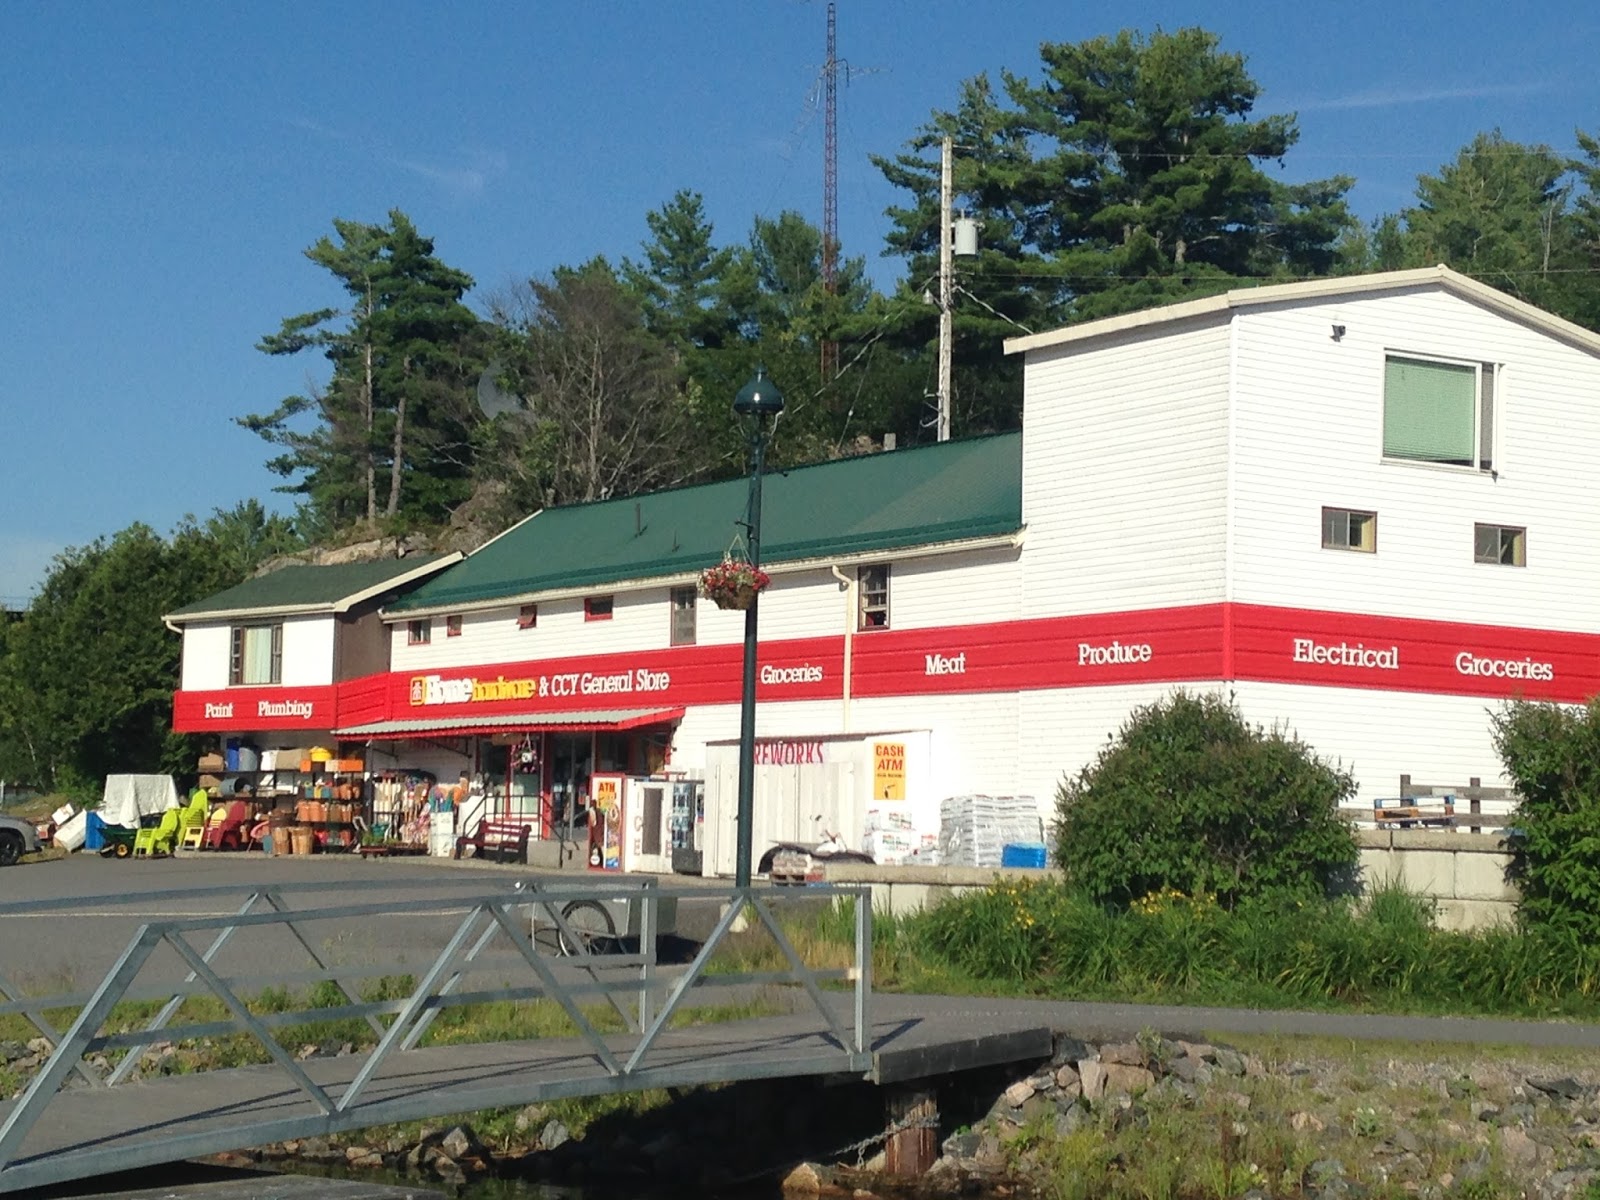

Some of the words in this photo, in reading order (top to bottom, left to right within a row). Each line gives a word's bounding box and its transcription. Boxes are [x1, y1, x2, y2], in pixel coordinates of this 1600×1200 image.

[925, 652, 966, 676] Meat
[1078, 641, 1152, 666] Produce
[1293, 638, 1399, 670] Electrical
[760, 663, 823, 685] Groceries
[1455, 652, 1554, 681] Groceries
[539, 676, 549, 697] &
[551, 673, 579, 697] CCY
[581, 670, 633, 694] General
[637, 668, 670, 691] Store
[204, 702, 234, 718] Paint
[258, 699, 313, 718] Plumbing
[875, 745, 904, 757] CASH
[877, 758, 903, 771] ATM
